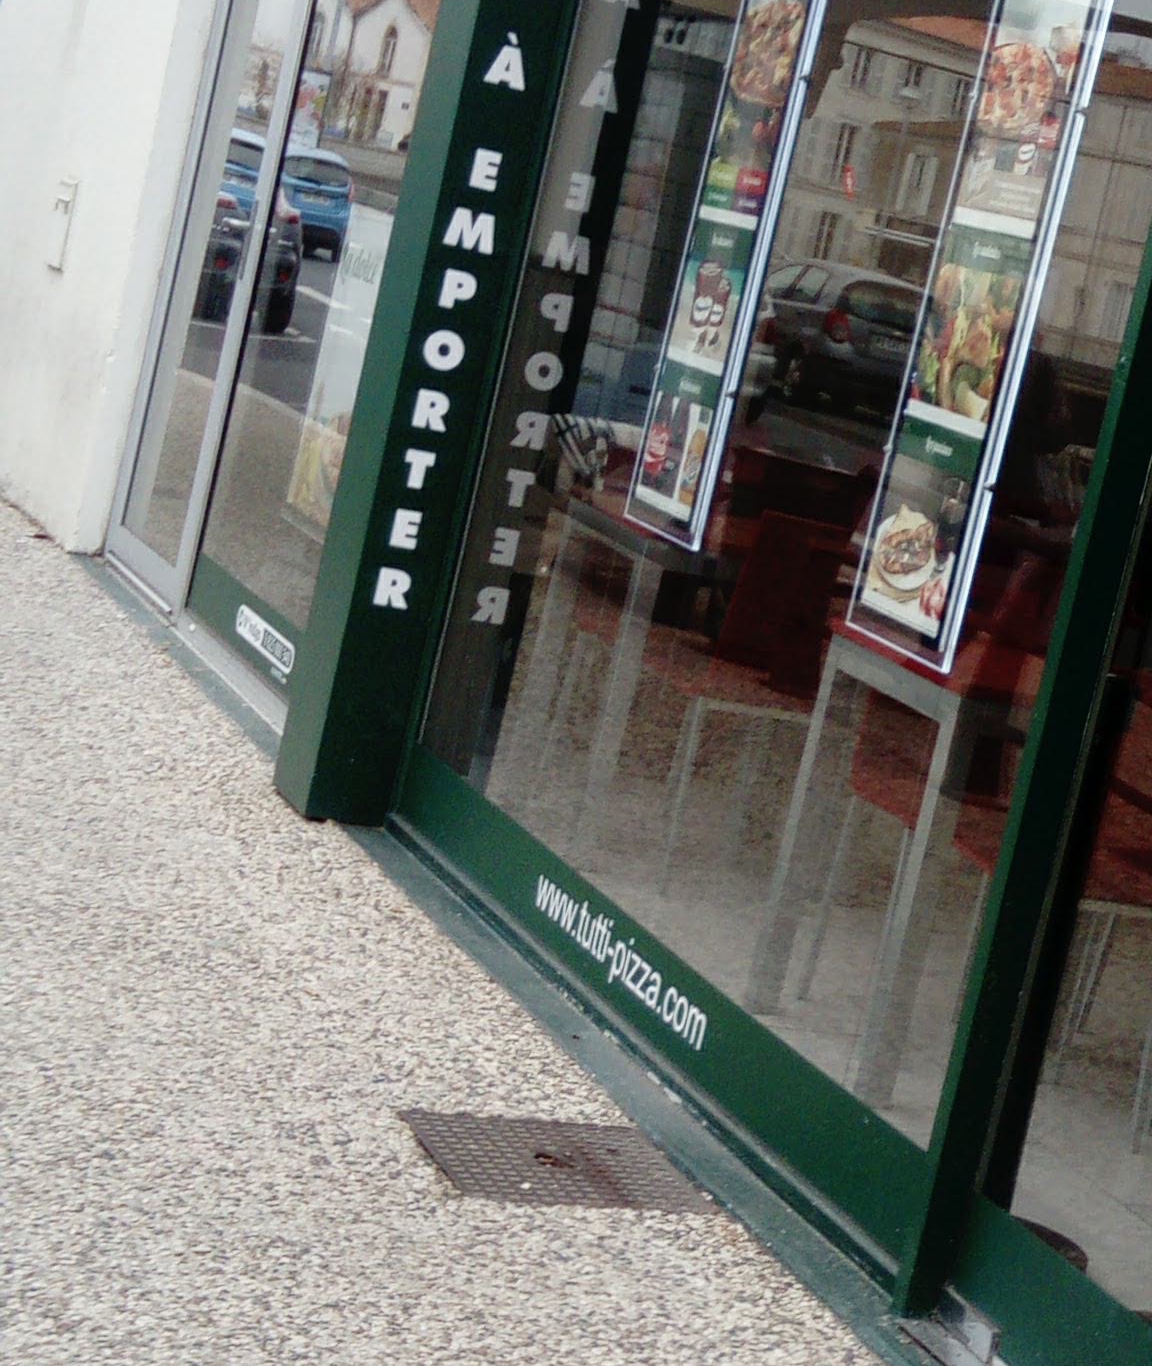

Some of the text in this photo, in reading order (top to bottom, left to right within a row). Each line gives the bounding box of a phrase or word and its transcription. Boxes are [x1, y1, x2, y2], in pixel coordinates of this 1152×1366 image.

[483, 32, 526, 92] À
[372, 148, 502, 610] EMPORTER
[535, 874, 708, 1051] www.tutti-pizza.com
